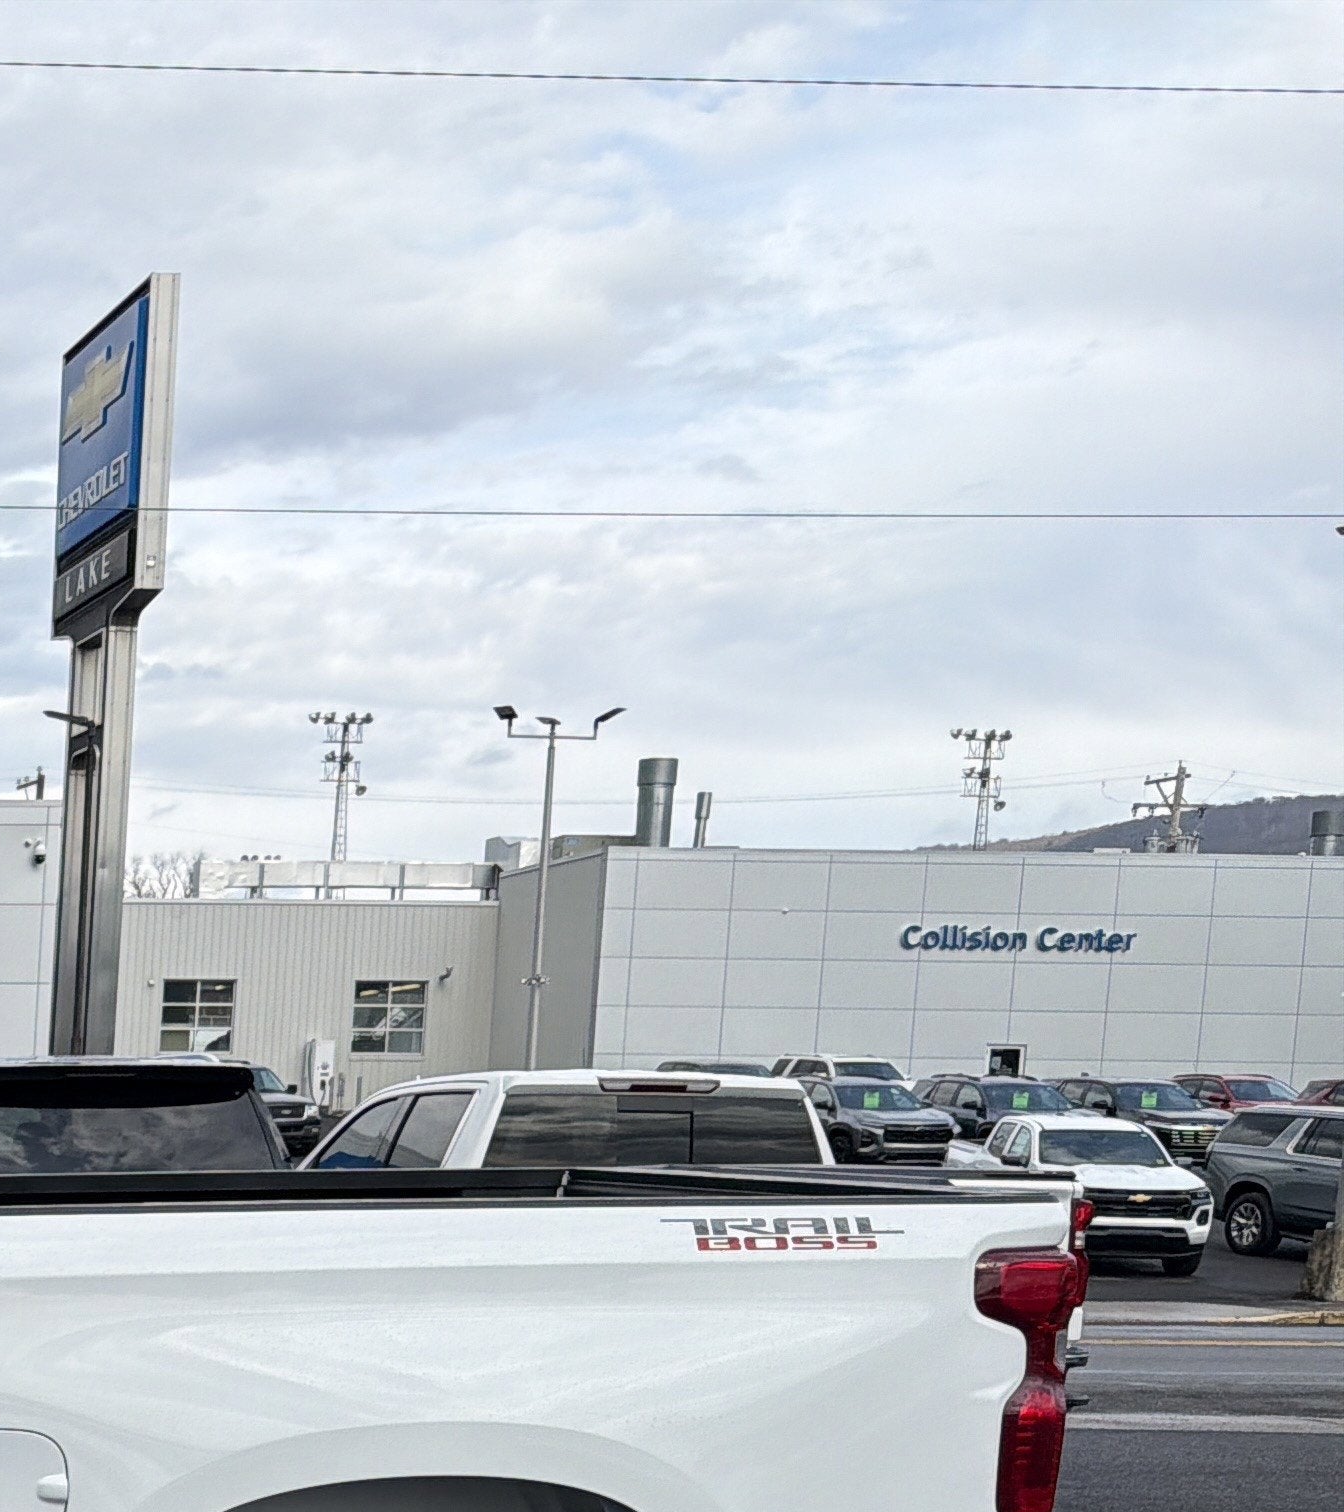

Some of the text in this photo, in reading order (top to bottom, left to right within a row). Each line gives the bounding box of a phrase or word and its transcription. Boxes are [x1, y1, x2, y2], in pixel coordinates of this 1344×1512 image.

[57, 451, 129, 531] CHEVROLET
[65, 550, 112, 604] LAKE
[900, 925, 1138, 953] Collision Center
[660, 1217, 905, 1236] TRAIL
[696, 1236, 878, 1251] BOSS
